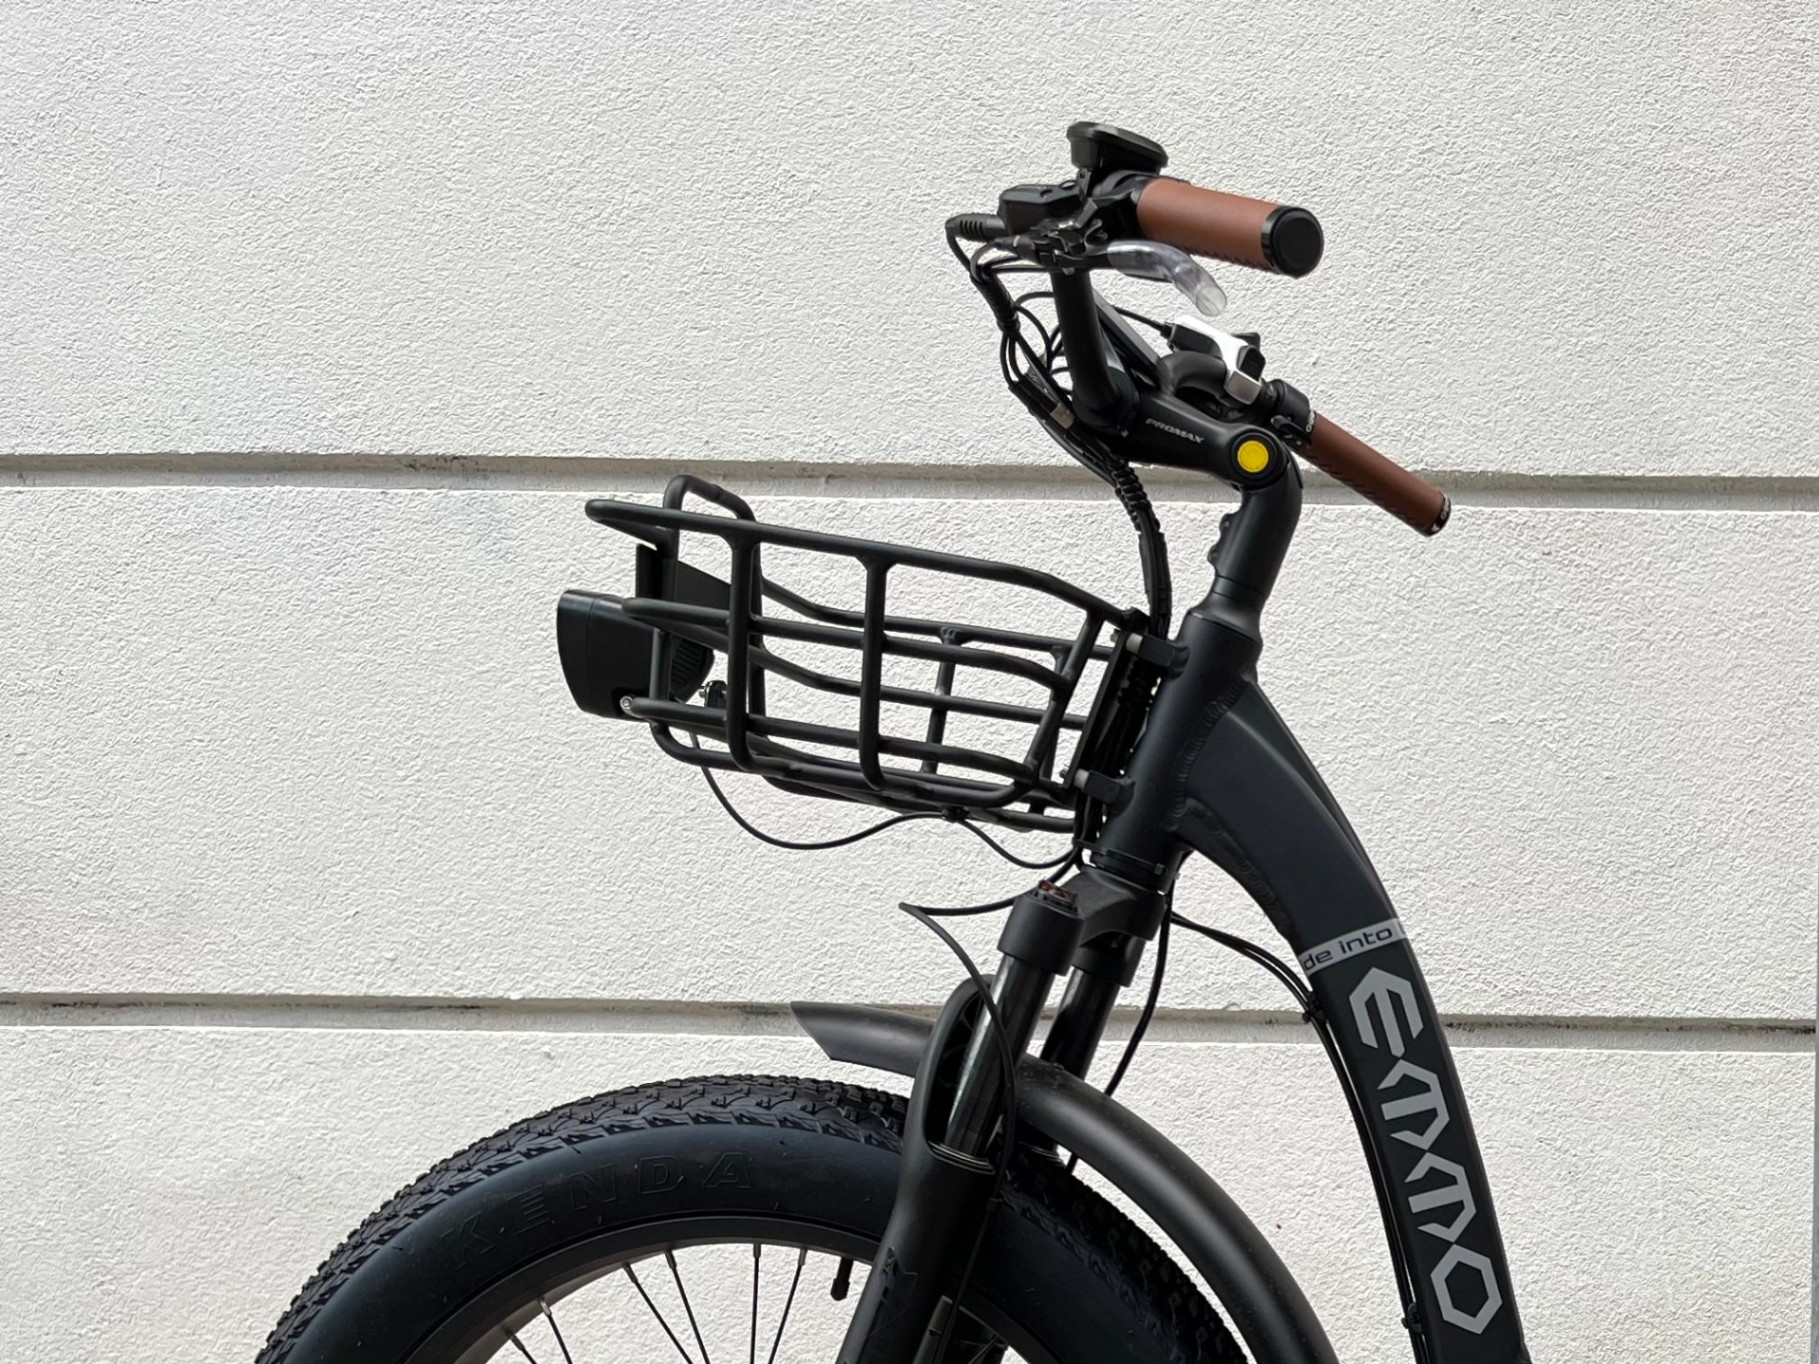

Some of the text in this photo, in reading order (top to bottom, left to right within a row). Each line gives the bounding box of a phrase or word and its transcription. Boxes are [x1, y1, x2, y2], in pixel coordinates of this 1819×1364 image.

[1339, 928, 1393, 954] into
[1349, 967, 1502, 1335] EMMO
[440, 1152, 752, 1271] KENDA
